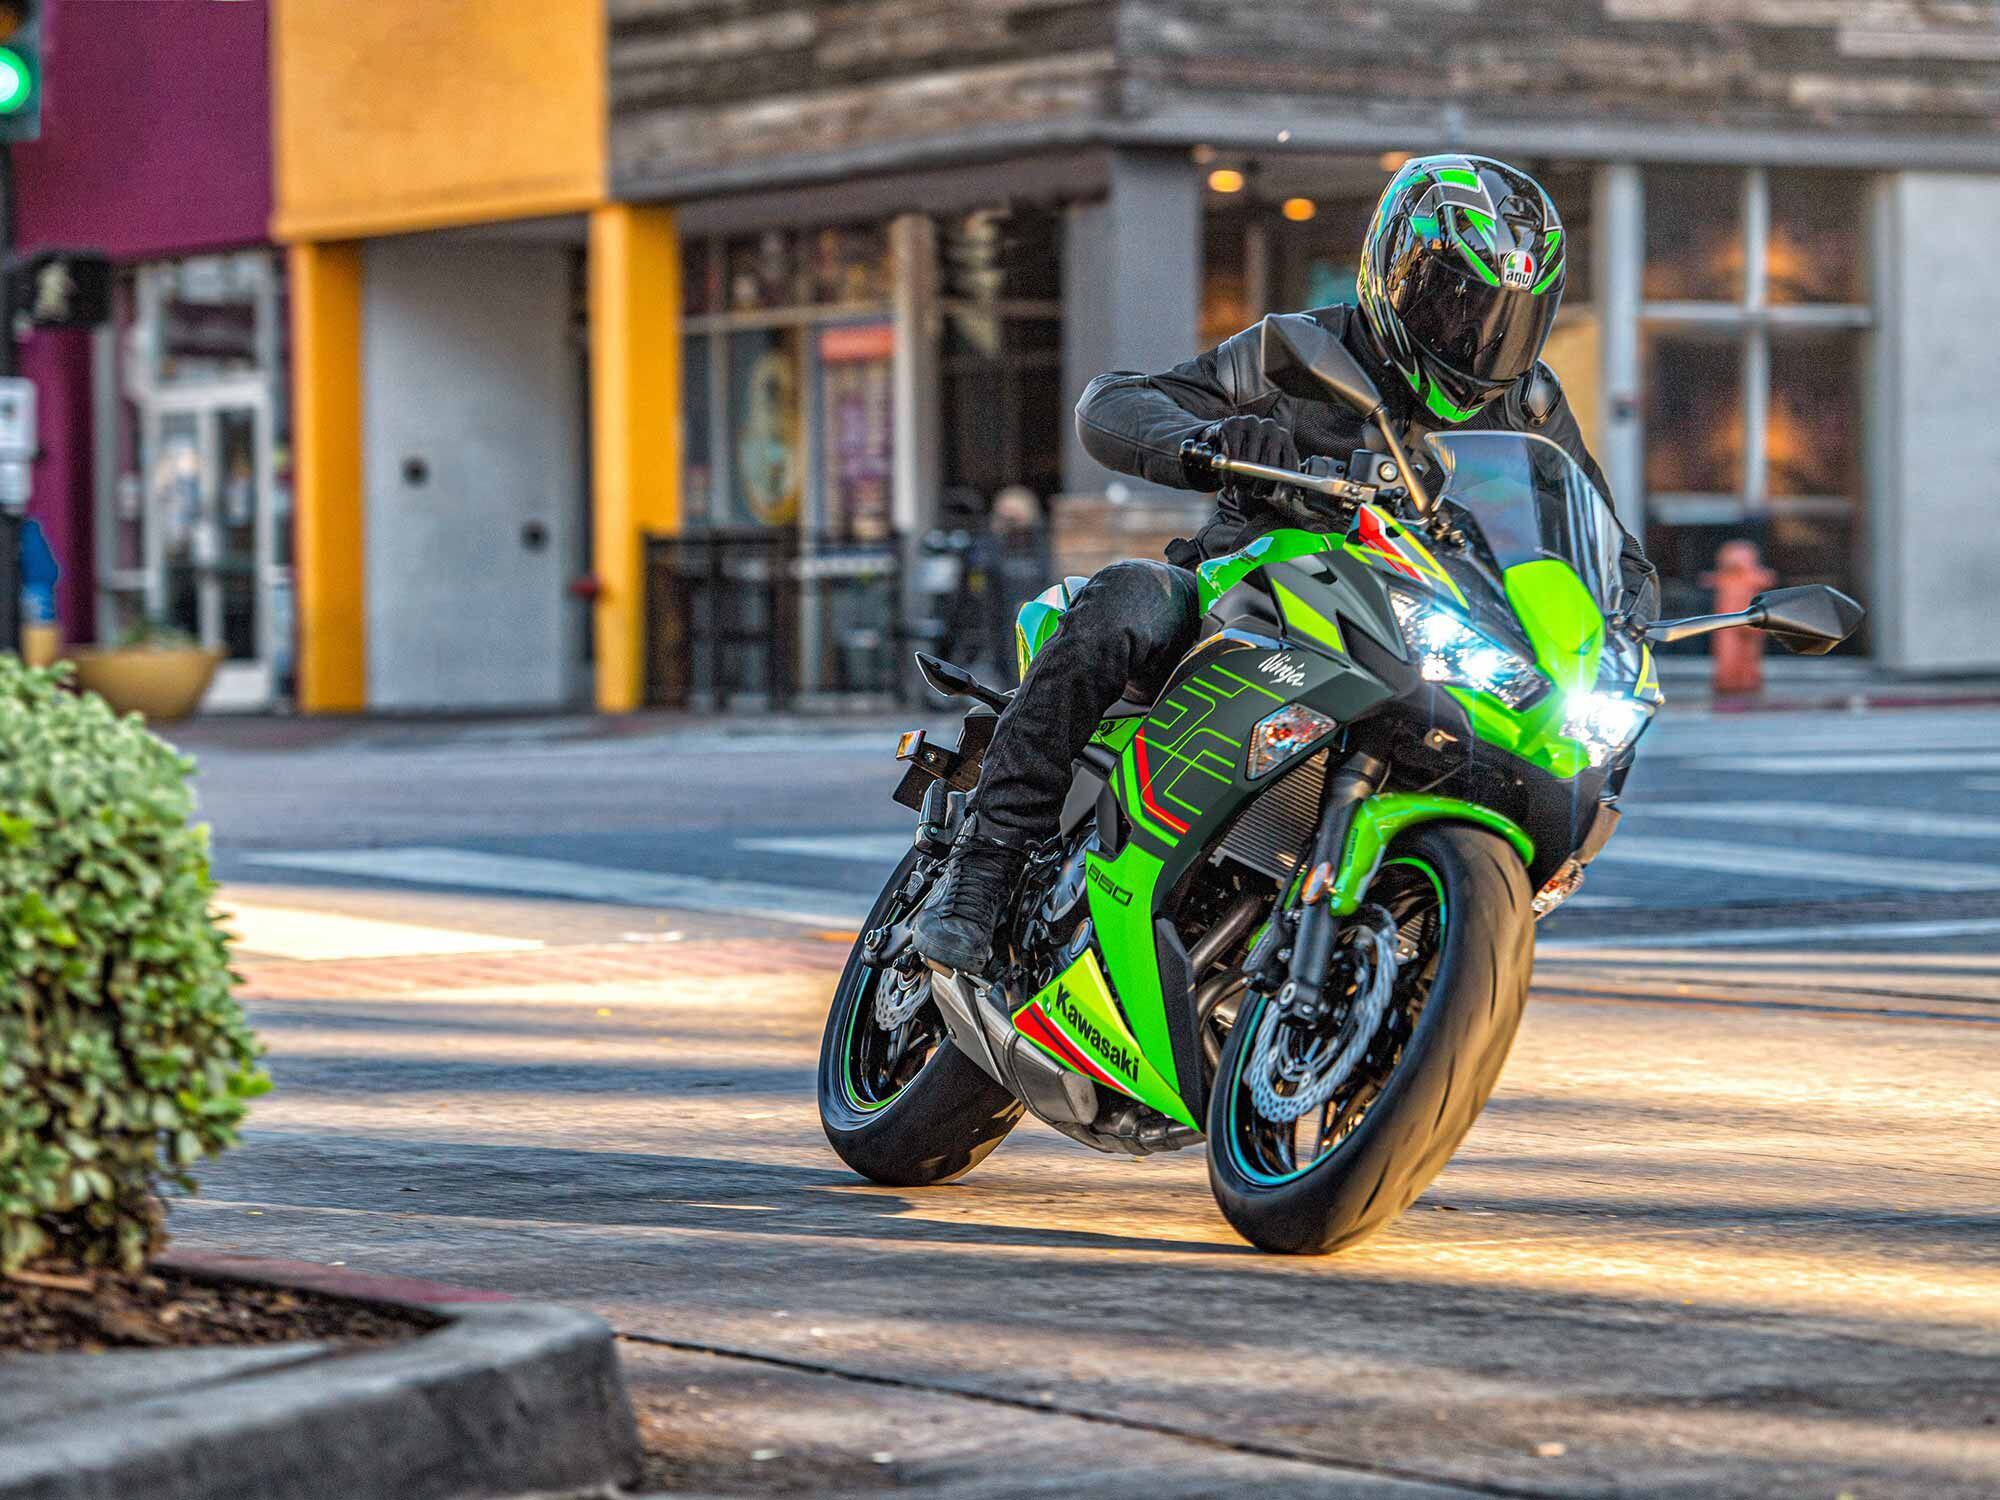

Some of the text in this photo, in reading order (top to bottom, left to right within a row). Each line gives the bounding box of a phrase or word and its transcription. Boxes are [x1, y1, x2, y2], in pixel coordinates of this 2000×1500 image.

[1256, 652, 1306, 687] Ninja
[1087, 862, 1134, 907] 650
[1055, 981, 1140, 1084] Kawasaki
